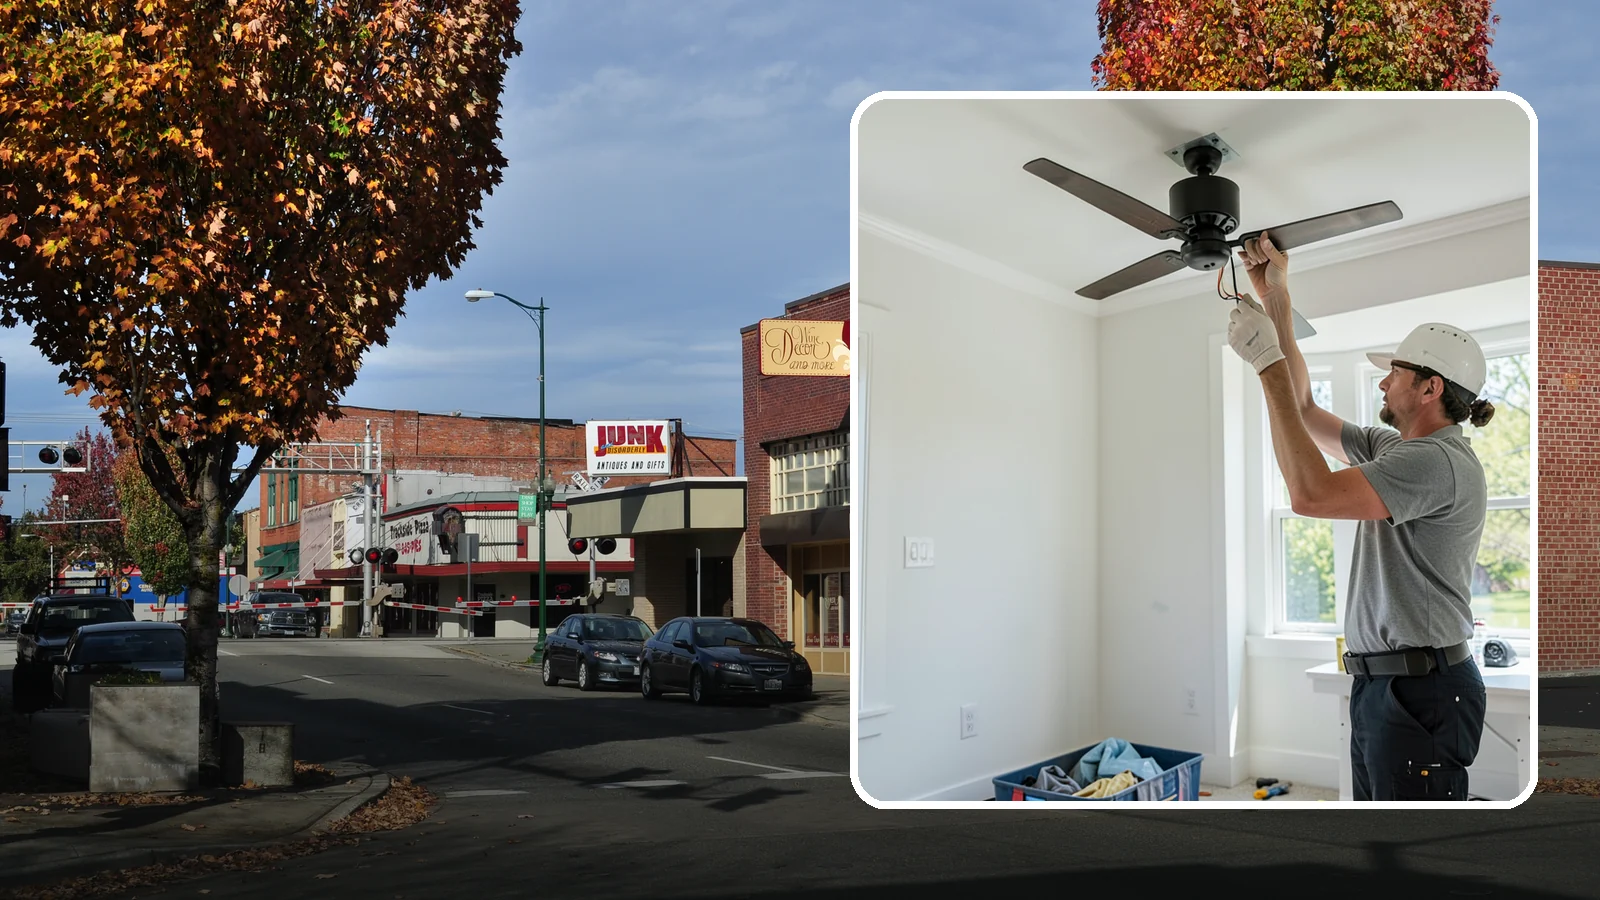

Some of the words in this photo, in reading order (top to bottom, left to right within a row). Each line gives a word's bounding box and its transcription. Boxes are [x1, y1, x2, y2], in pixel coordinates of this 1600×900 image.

[596, 425, 665, 457] JUNK
[607, 446, 646, 454] DISORDERLY
[597, 461, 628, 470] ANTIQUES
[631, 461, 644, 470] AND
[647, 460, 665, 469] GIFTS
